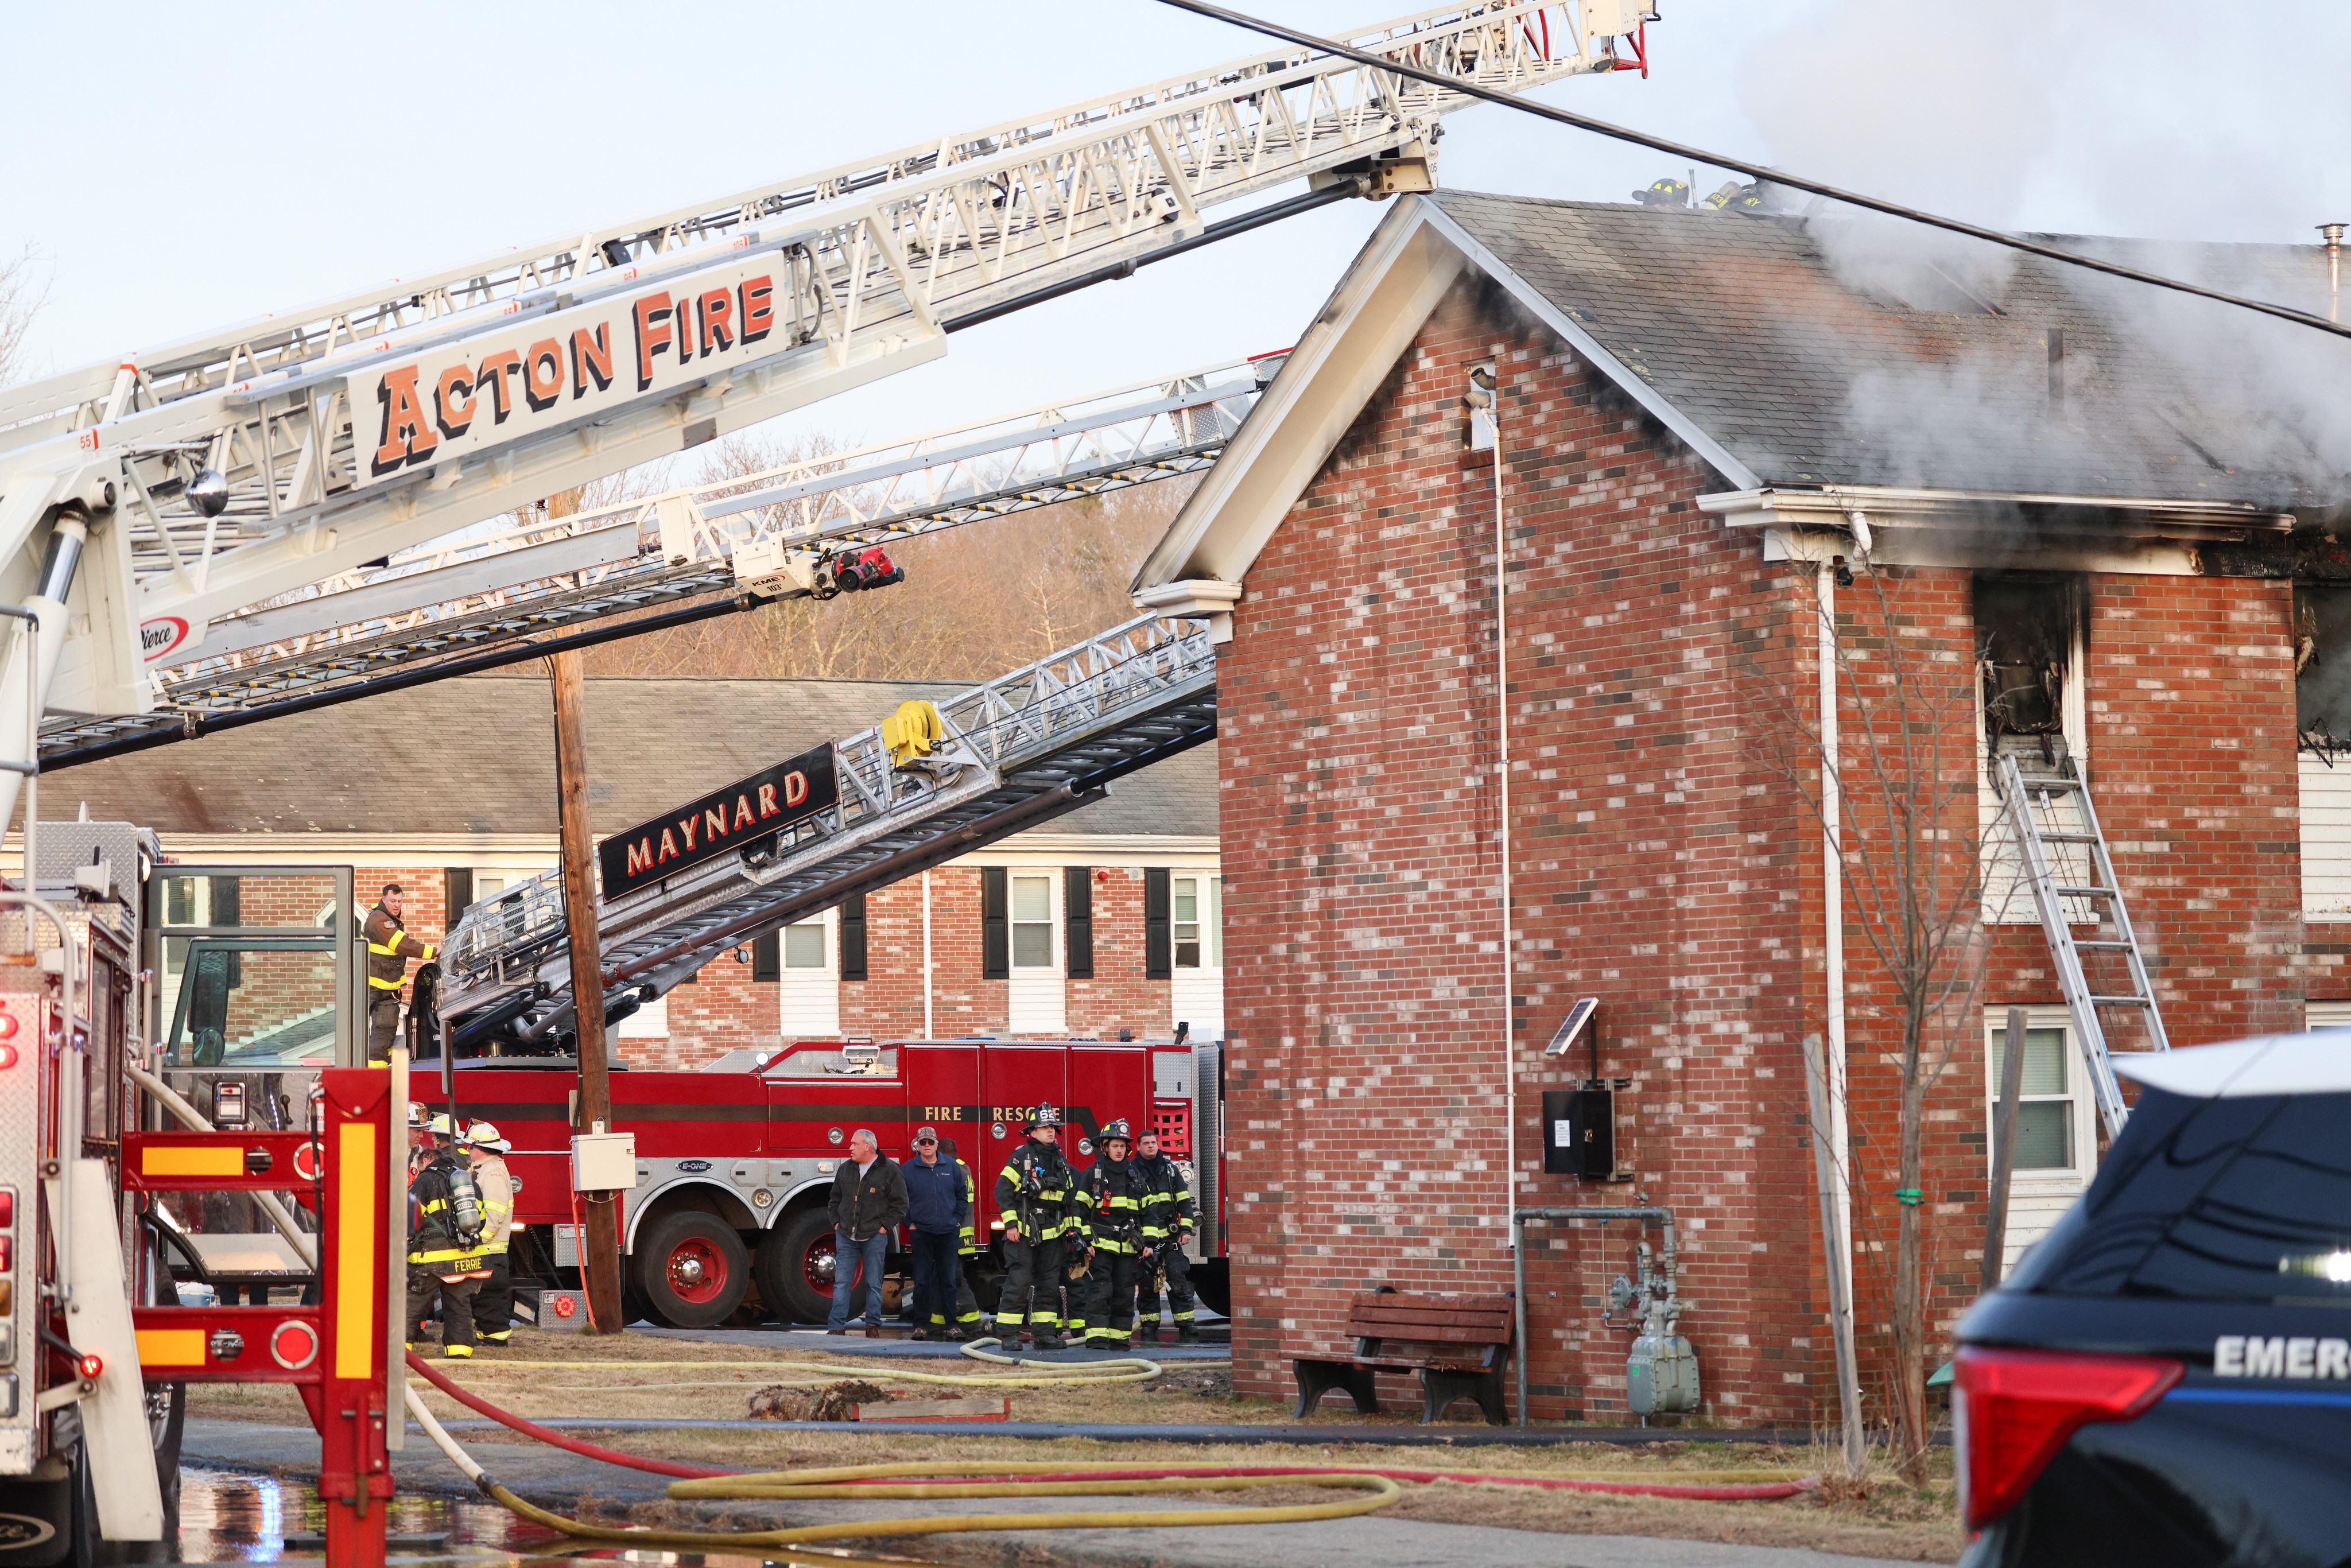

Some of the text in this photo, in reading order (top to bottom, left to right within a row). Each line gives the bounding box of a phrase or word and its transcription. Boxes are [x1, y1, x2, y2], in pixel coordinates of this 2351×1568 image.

[371, 274, 775, 477] ACTON FIRE
[80, 434, 91, 449] 55
[752, 576, 781, 587] KME
[627, 770, 809, 878] MAYNARD
[925, 1107, 1060, 1121] FIRE RESCE
[1039, 1109, 1054, 1119] 62
[457, 1202, 472, 1210] MSA
[455, 1257, 482, 1272] FERRIE
[2213, 1334, 2351, 1380] EMER
